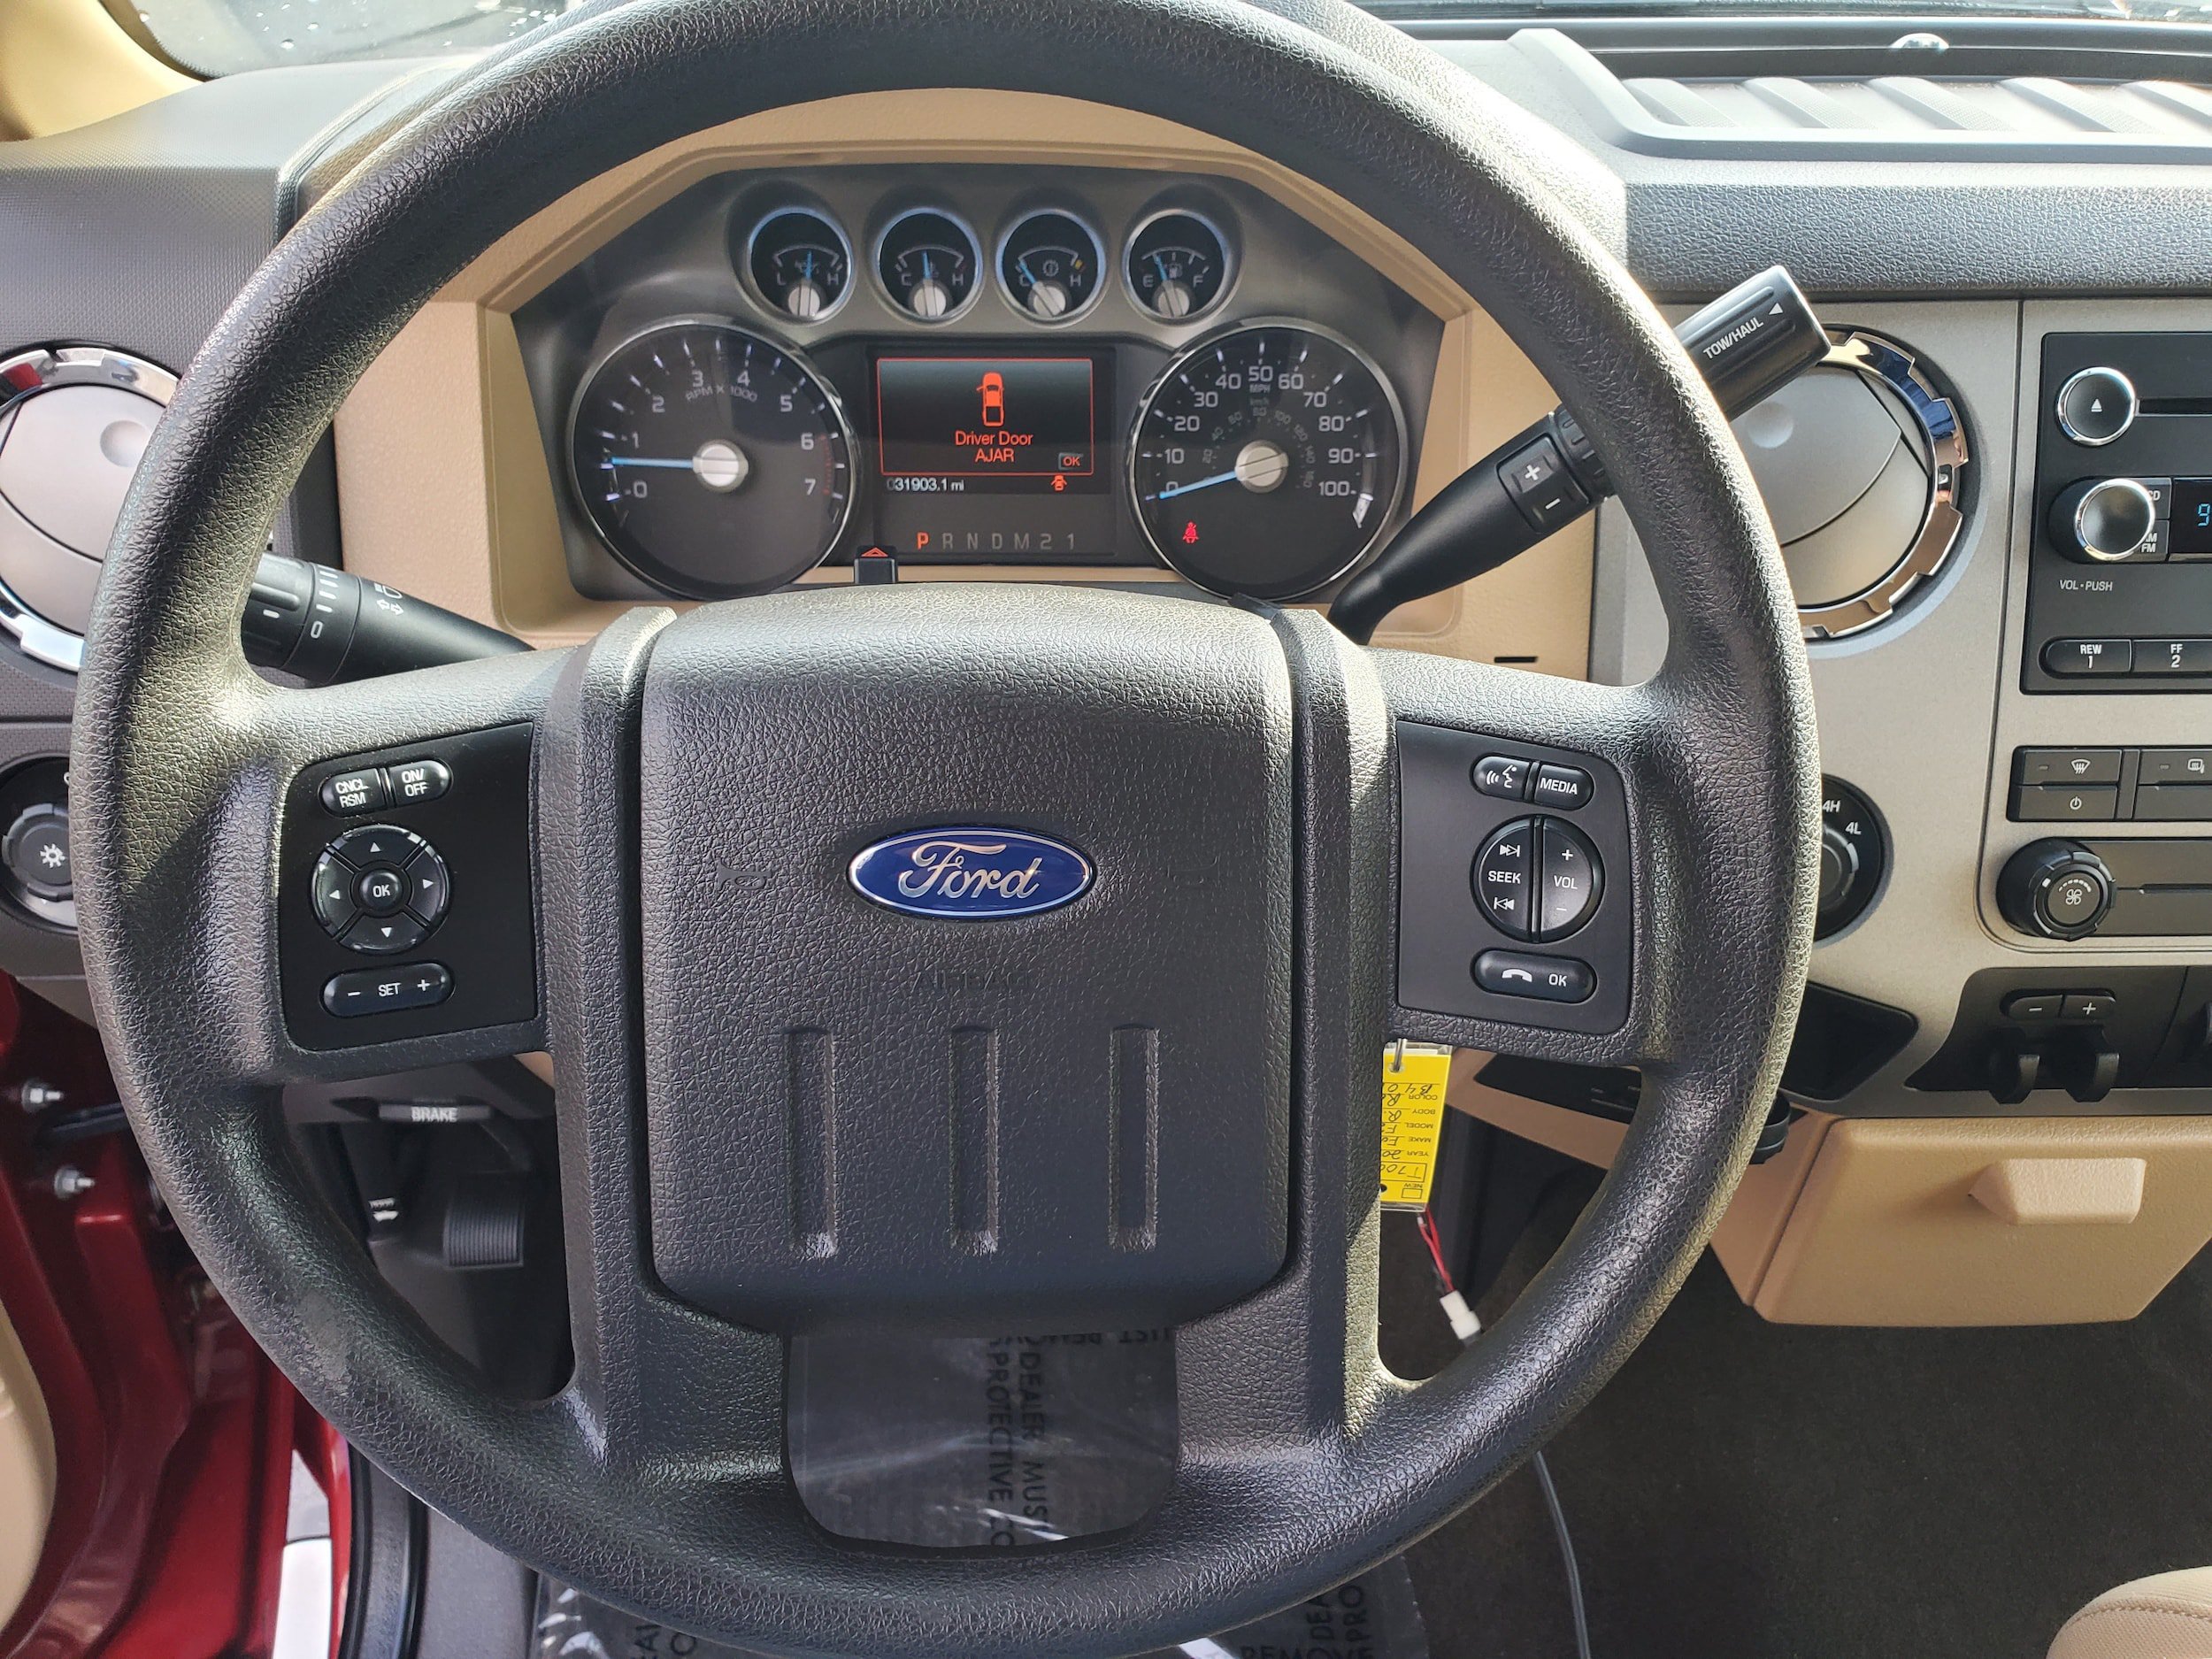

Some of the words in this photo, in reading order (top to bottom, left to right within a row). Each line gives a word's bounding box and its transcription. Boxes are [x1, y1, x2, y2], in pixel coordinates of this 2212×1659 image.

[826, 273, 840, 286] H
[951, 273, 964, 286] H
[1069, 273, 1082, 287] H
[1142, 273, 1155, 288] E
[1193, 274, 1204, 288] F
[1702, 316, 1765, 360] TOW/HAUL
[691, 369, 704, 388] 3
[736, 369, 751, 388] 4
[1215, 373, 1242, 390] 40
[1248, 365, 1274, 383] 50
[1278, 373, 1305, 390] 60
[729, 385, 759, 403] 1000
[1194, 391, 1219, 408] 30
[1302, 391, 1328, 408] 70
[652, 395, 666, 414] 2
[780, 395, 794, 412] 5
[1173, 415, 1201, 432] 20
[1317, 415, 1345, 432] 80
[631, 431, 641, 449] 1
[801, 432, 815, 449] 6
[954, 431, 995, 446] Driver
[998, 432, 1033, 446] Door
[974, 449, 1016, 463] AJAR
[1063, 455, 1081, 467] OK
[1164, 449, 1185, 465] 10
[1328, 449, 1354, 465] 90
[632, 480, 648, 498] 0
[804, 478, 818, 496] 7
[950, 479, 964, 491] mi
[1317, 481, 1351, 496] 100
[917, 533, 929, 549] P
[941, 533, 954, 549] R
[967, 533, 979, 549] N
[992, 534, 1003, 549] D
[1014, 534, 1030, 549] M
[1040, 534, 1053, 549] 2
[1067, 534, 1075, 549] 1
[2141, 543, 2156, 553] FM
[310, 620, 324, 640] 0
[2080, 644, 2101, 655] REW
[2170, 644, 2183, 654] FF
[2087, 655, 2094, 669] 1
[2170, 655, 2181, 668] 2
[401, 767, 425, 783] ON/
[334, 778, 368, 794] CNCL
[404, 782, 428, 797] OFF
[1540, 777, 1578, 795] MEDIA
[339, 795, 366, 809] RSM
[1823, 799, 1841, 813] 4H
[1845, 821, 1863, 835] 4L
[899, 841, 1043, 899] Ford
[1487, 871, 1521, 884] SEEK
[1554, 875, 1578, 889] VOL
[373, 883, 391, 898] OK
[1548, 973, 1567, 987] OK
[378, 982, 402, 996] SET
[411, 1106, 458, 1124] BRAKE
[986, 1352, 1014, 1502] PROTECTIVE
